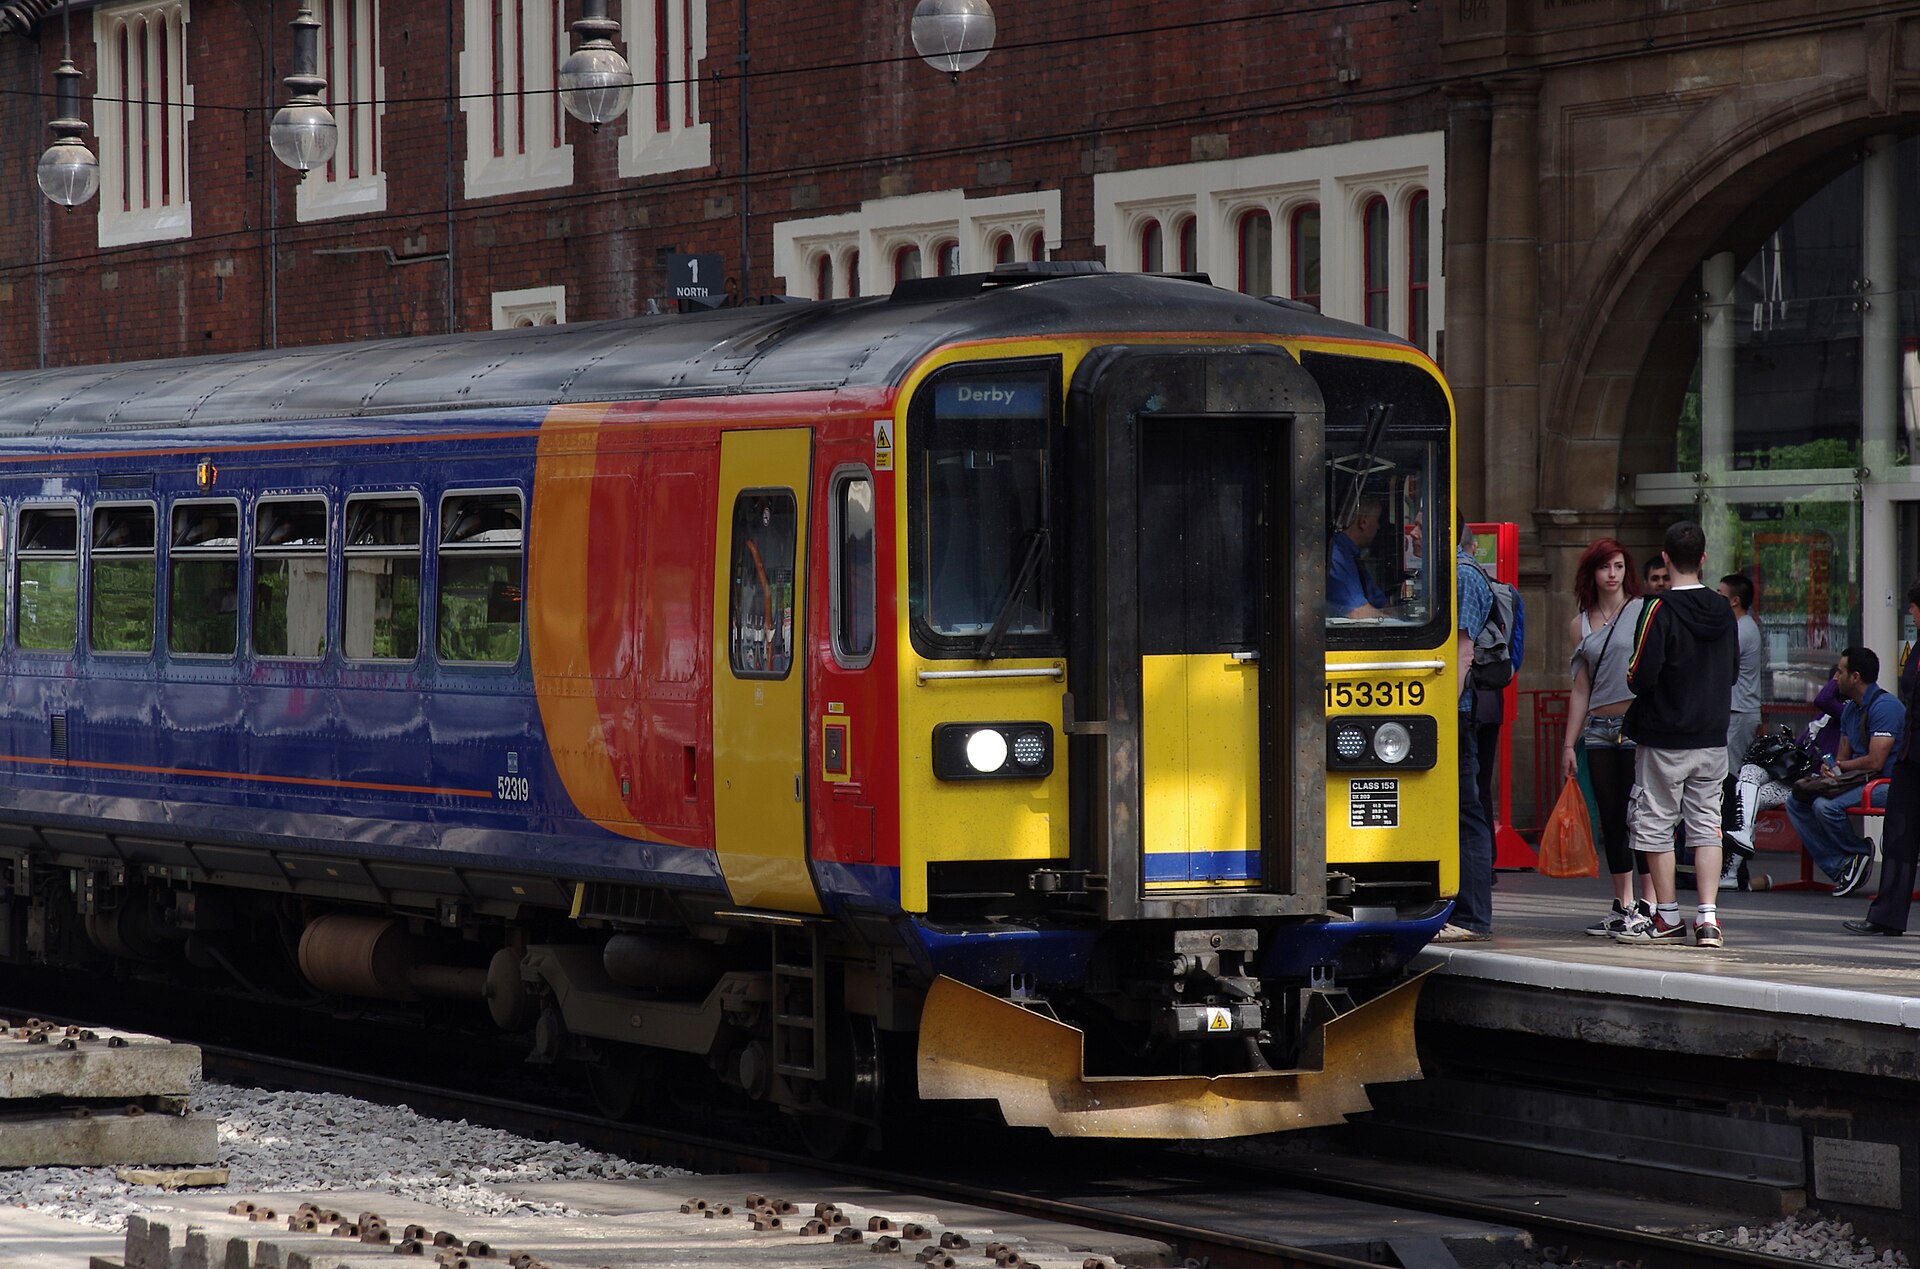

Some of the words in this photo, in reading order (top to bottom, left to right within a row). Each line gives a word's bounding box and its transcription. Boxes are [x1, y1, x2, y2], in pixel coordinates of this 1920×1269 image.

[688, 259, 698, 283] 1
[676, 287, 709, 297] NORTH
[958, 386, 1015, 405] Derby
[1325, 681, 1425, 708] 153319
[497, 776, 529, 802] 52319
[1352, 782, 1379, 790] CLASS
[1381, 782, 1395, 790] 153
